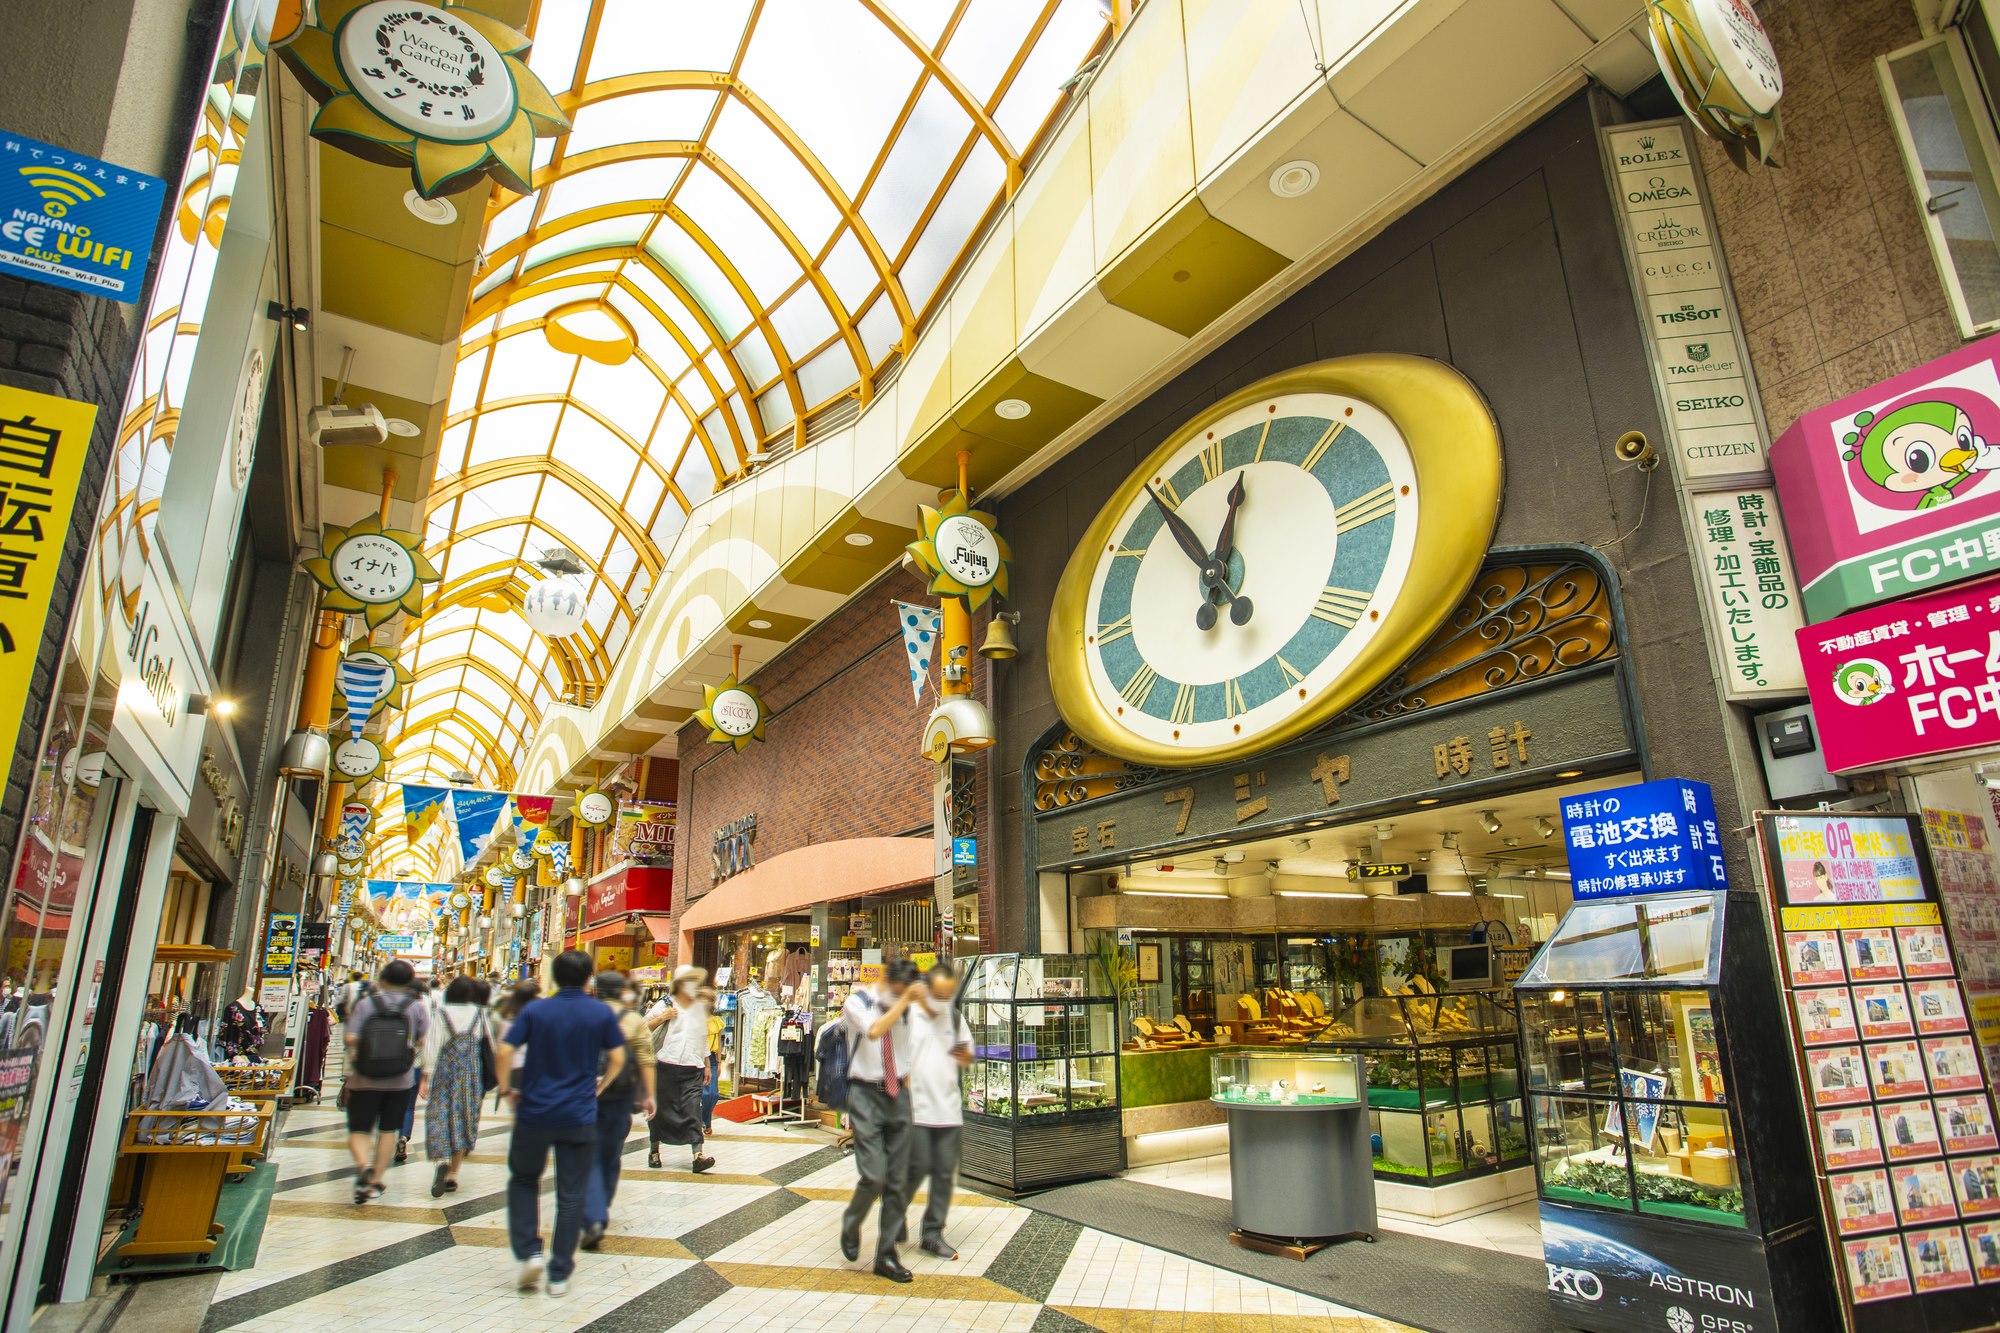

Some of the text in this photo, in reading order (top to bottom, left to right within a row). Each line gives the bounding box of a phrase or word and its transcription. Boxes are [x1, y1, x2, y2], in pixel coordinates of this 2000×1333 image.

[403, 30, 464, 64] Wacoal
[399, 44, 461, 77] Garden
[362, 66, 476, 121] サンモール
[1619, 149, 1683, 167] ROLEX
[1628, 187, 1693, 204] OMEGA
[12, 208, 91, 238] NAKANO
[1637, 226, 1702, 242] CREDOR
[0, 219, 133, 270] EE WIFI
[24, 247, 62, 264] PLUS
[1646, 261, 1712, 277] GUCCI
[1656, 308, 1722, 324] TISSOT
[1676, 395, 1744, 412] SEIKO
[1686, 442, 1756, 460] CITIZEN
[957, 546, 988, 567] Fujiya
[1737, 494, 1789, 610] 時計・宝飾品の
[350, 557, 398, 577] イナバ
[950, 559, 990, 578] サンモール
[343, 576, 395, 595] サンモール
[1704, 509, 1768, 687] 修理・加工いたします。
[140, 624, 177, 728] Garden
[721, 704, 752, 720] STOCK
[935, 742, 945, 752] E09
[1072, 721, 1532, 855] 宝石 フジヤ 時計
[457, 795, 493, 807] SUMMER
[1566, 797, 1621, 820] 時計の
[1570, 812, 1679, 849] 電池交換
[1682, 788, 1703, 850] 時計
[711, 829, 757, 880] STOCK
[1605, 844, 1682, 870] すぐ出来ます
[1703, 819, 1725, 882] 宝石
[1366, 865, 1402, 876] フジヤ
[1577, 868, 1687, 893] 時計の修理承ります
[1650, 1272, 1754, 1308] ASTRON
